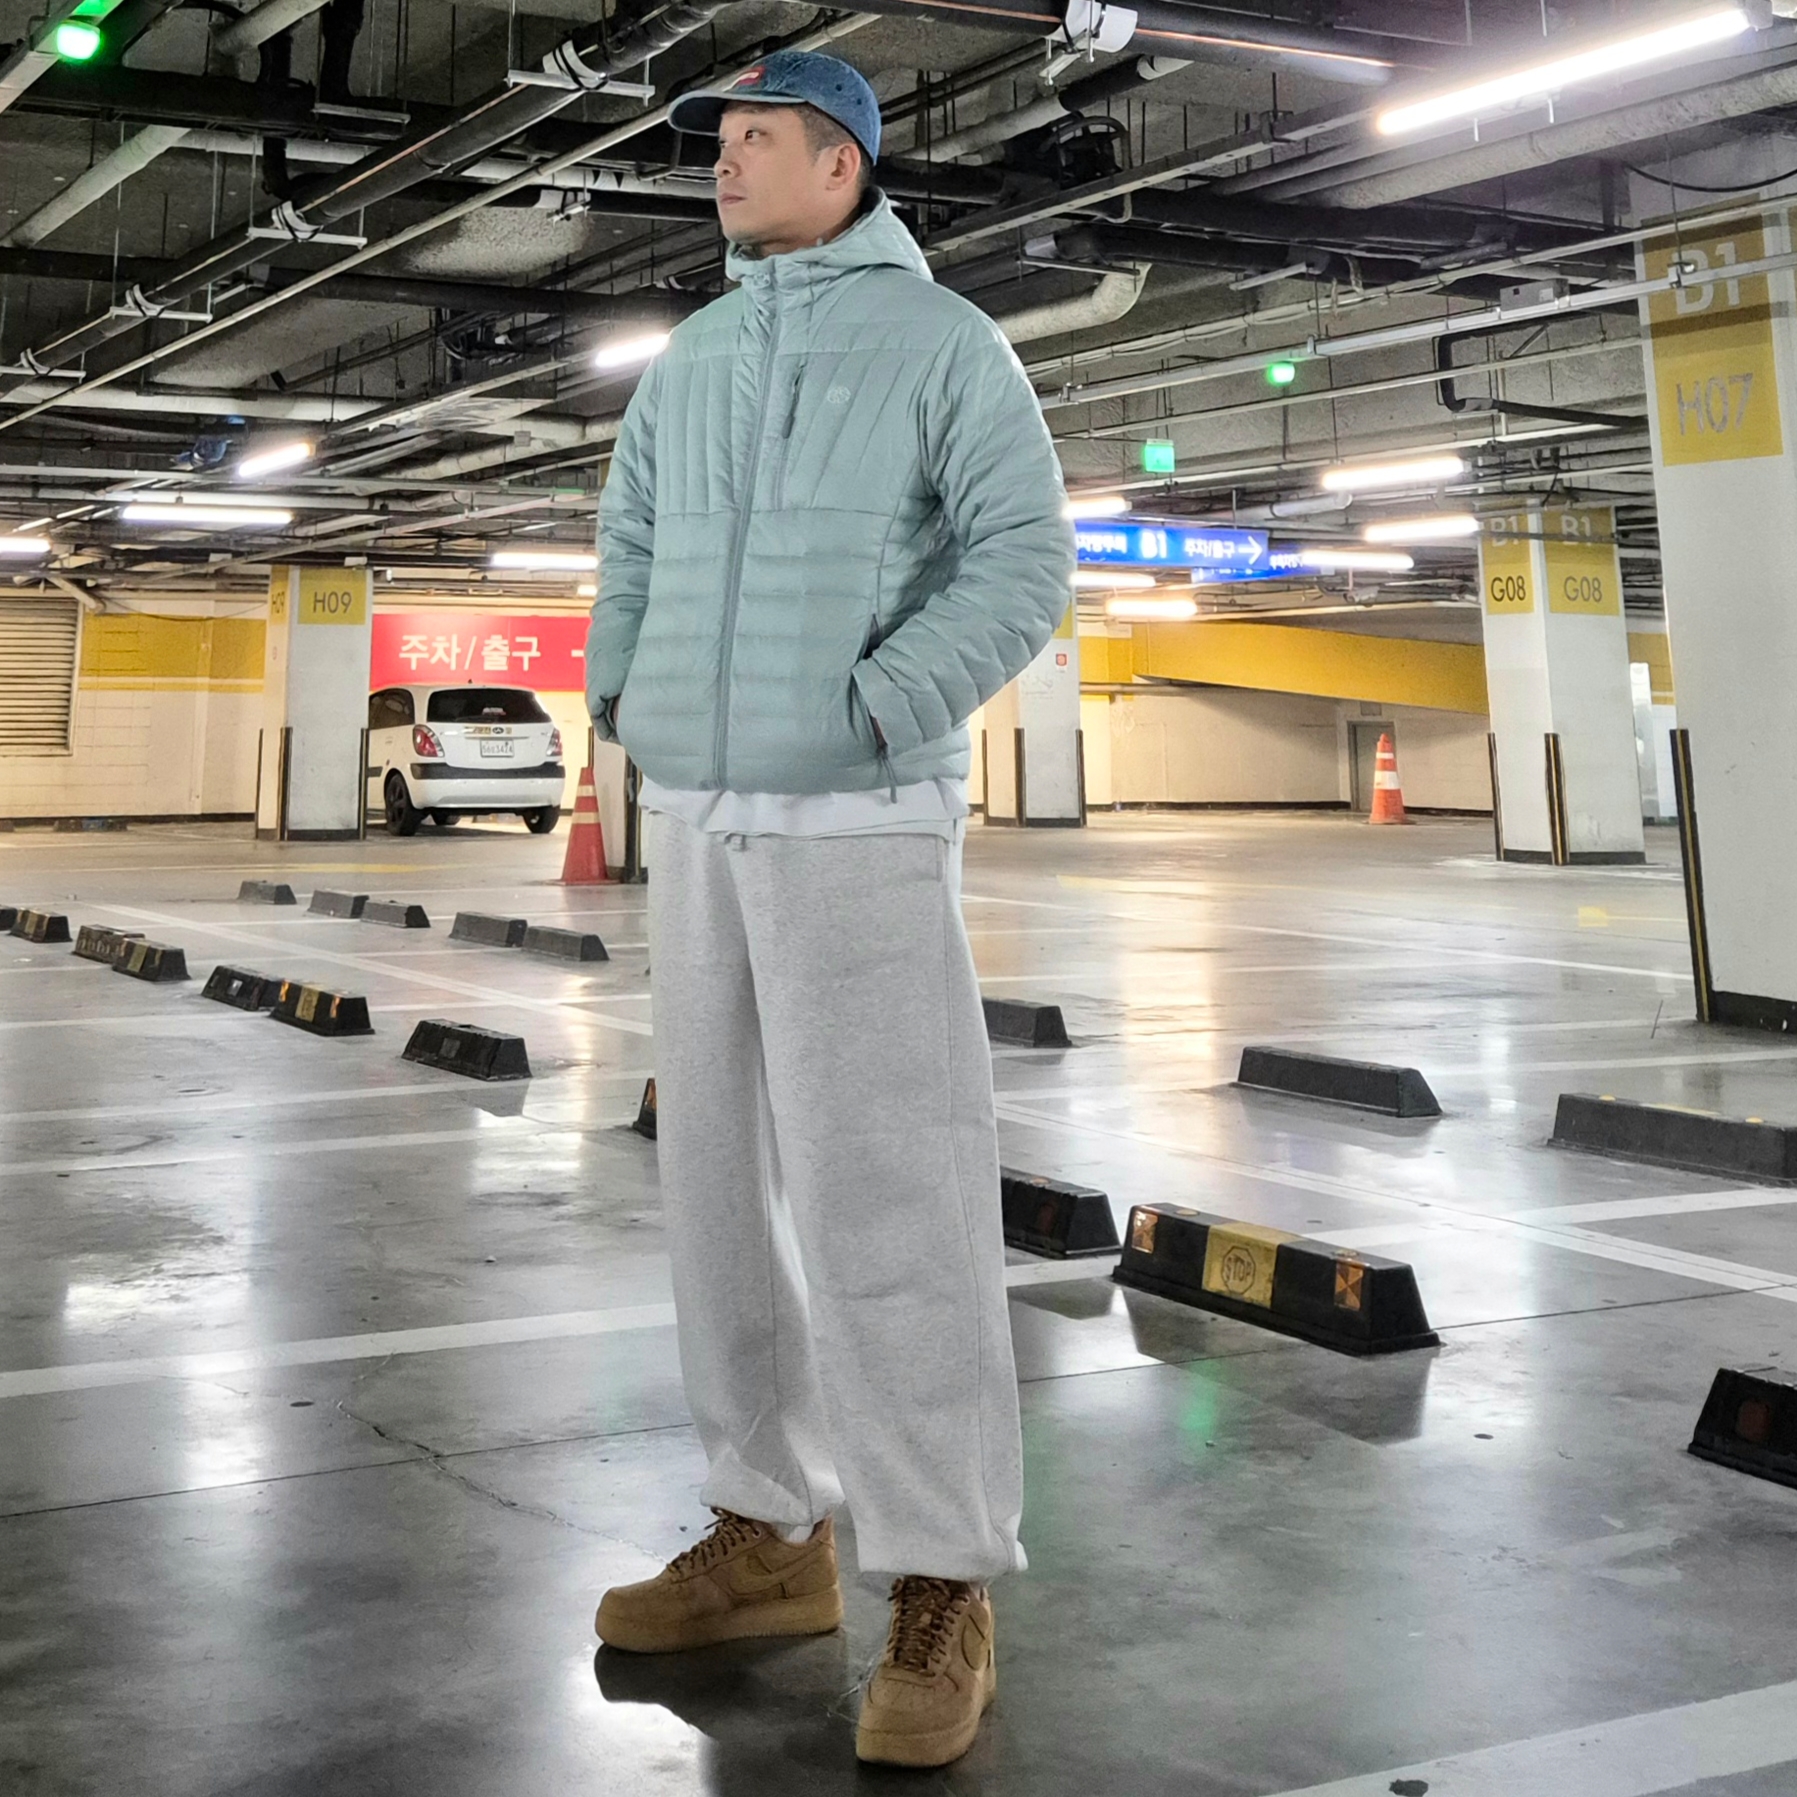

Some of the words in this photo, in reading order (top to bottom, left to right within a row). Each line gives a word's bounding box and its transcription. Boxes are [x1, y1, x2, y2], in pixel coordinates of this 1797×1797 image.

[1670, 241, 1740, 315] B1
[1675, 373, 1753, 436] H07
[1489, 515, 1519, 547] B1
[1561, 514, 1592, 546] B1
[312, 591, 352, 614] H09
[1490, 575, 1526, 602] G08
[1563, 575, 1603, 602] G08
[1225, 1254, 1252, 1283] STOP
